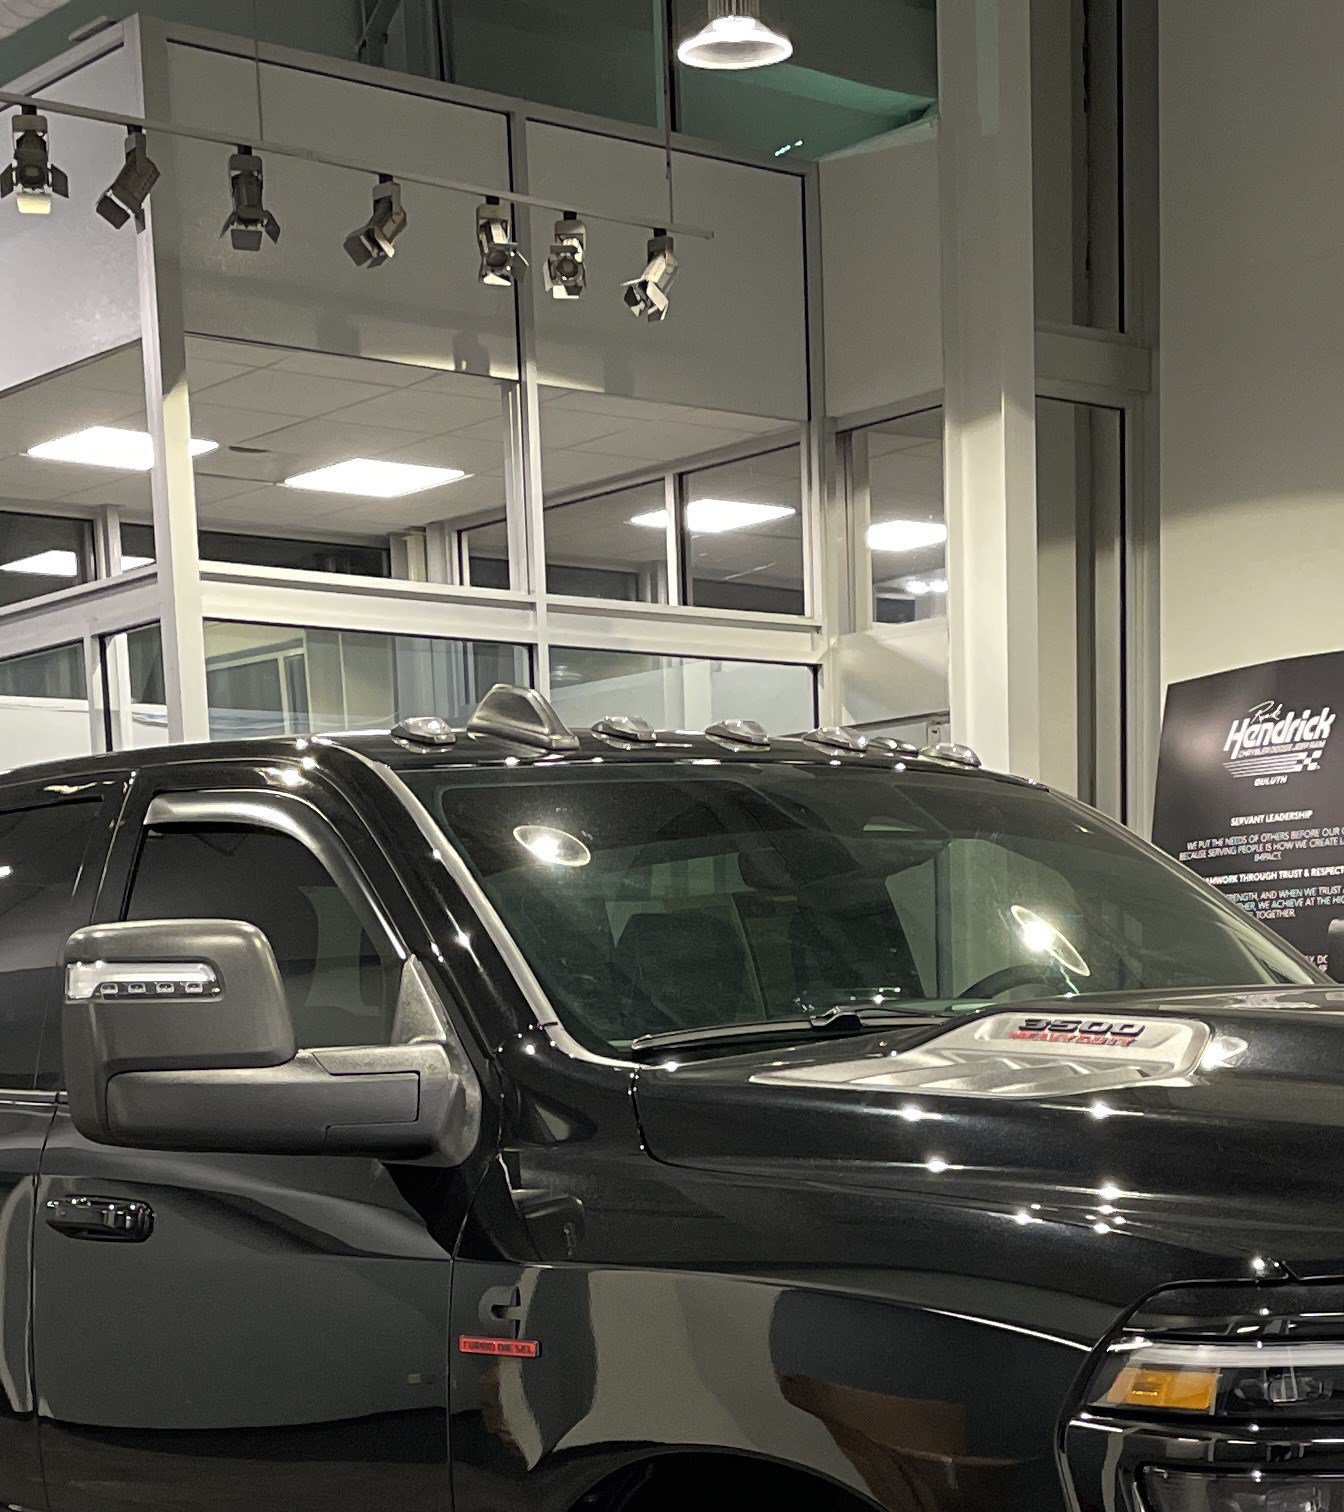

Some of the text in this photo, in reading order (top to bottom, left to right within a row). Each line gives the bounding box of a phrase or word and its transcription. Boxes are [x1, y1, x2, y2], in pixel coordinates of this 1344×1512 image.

[1223, 707, 1336, 760] Hendrick
[1230, 810, 1313, 827] SERVANT LEADERSHIP
[1225, 835, 1247, 845] NEEDS
[1248, 834, 1259, 843] OF
[1260, 831, 1290, 842] OTHERS
[1290, 829, 1320, 839] BEFORE
[1322, 827, 1340, 837] OUR
[1207, 846, 1237, 858] SERVING
[1237, 843, 1264, 854] PEOPLE
[1273, 841, 1294, 851] HOW
[1295, 839, 1308, 849] WE
[1309, 837, 1338, 848] CREATE
[1239, 871, 1277, 883] THROUGH
[1279, 869, 1303, 880] TRUST
[1304, 868, 1309, 878] &
[1311, 865, 1344, 877] RESPECT
[1260, 890, 1277, 900] AND
[1279, 888, 1303, 898] WHEN
[1304, 887, 1317, 897] WE
[1318, 885, 1341, 895] TRUST
[1271, 897, 1304, 908] ACHIEVE
[1305, 897, 1316, 906] AT
[1317, 896, 1331, 906] THE
[1018, 1018, 1145, 1038] 3500
